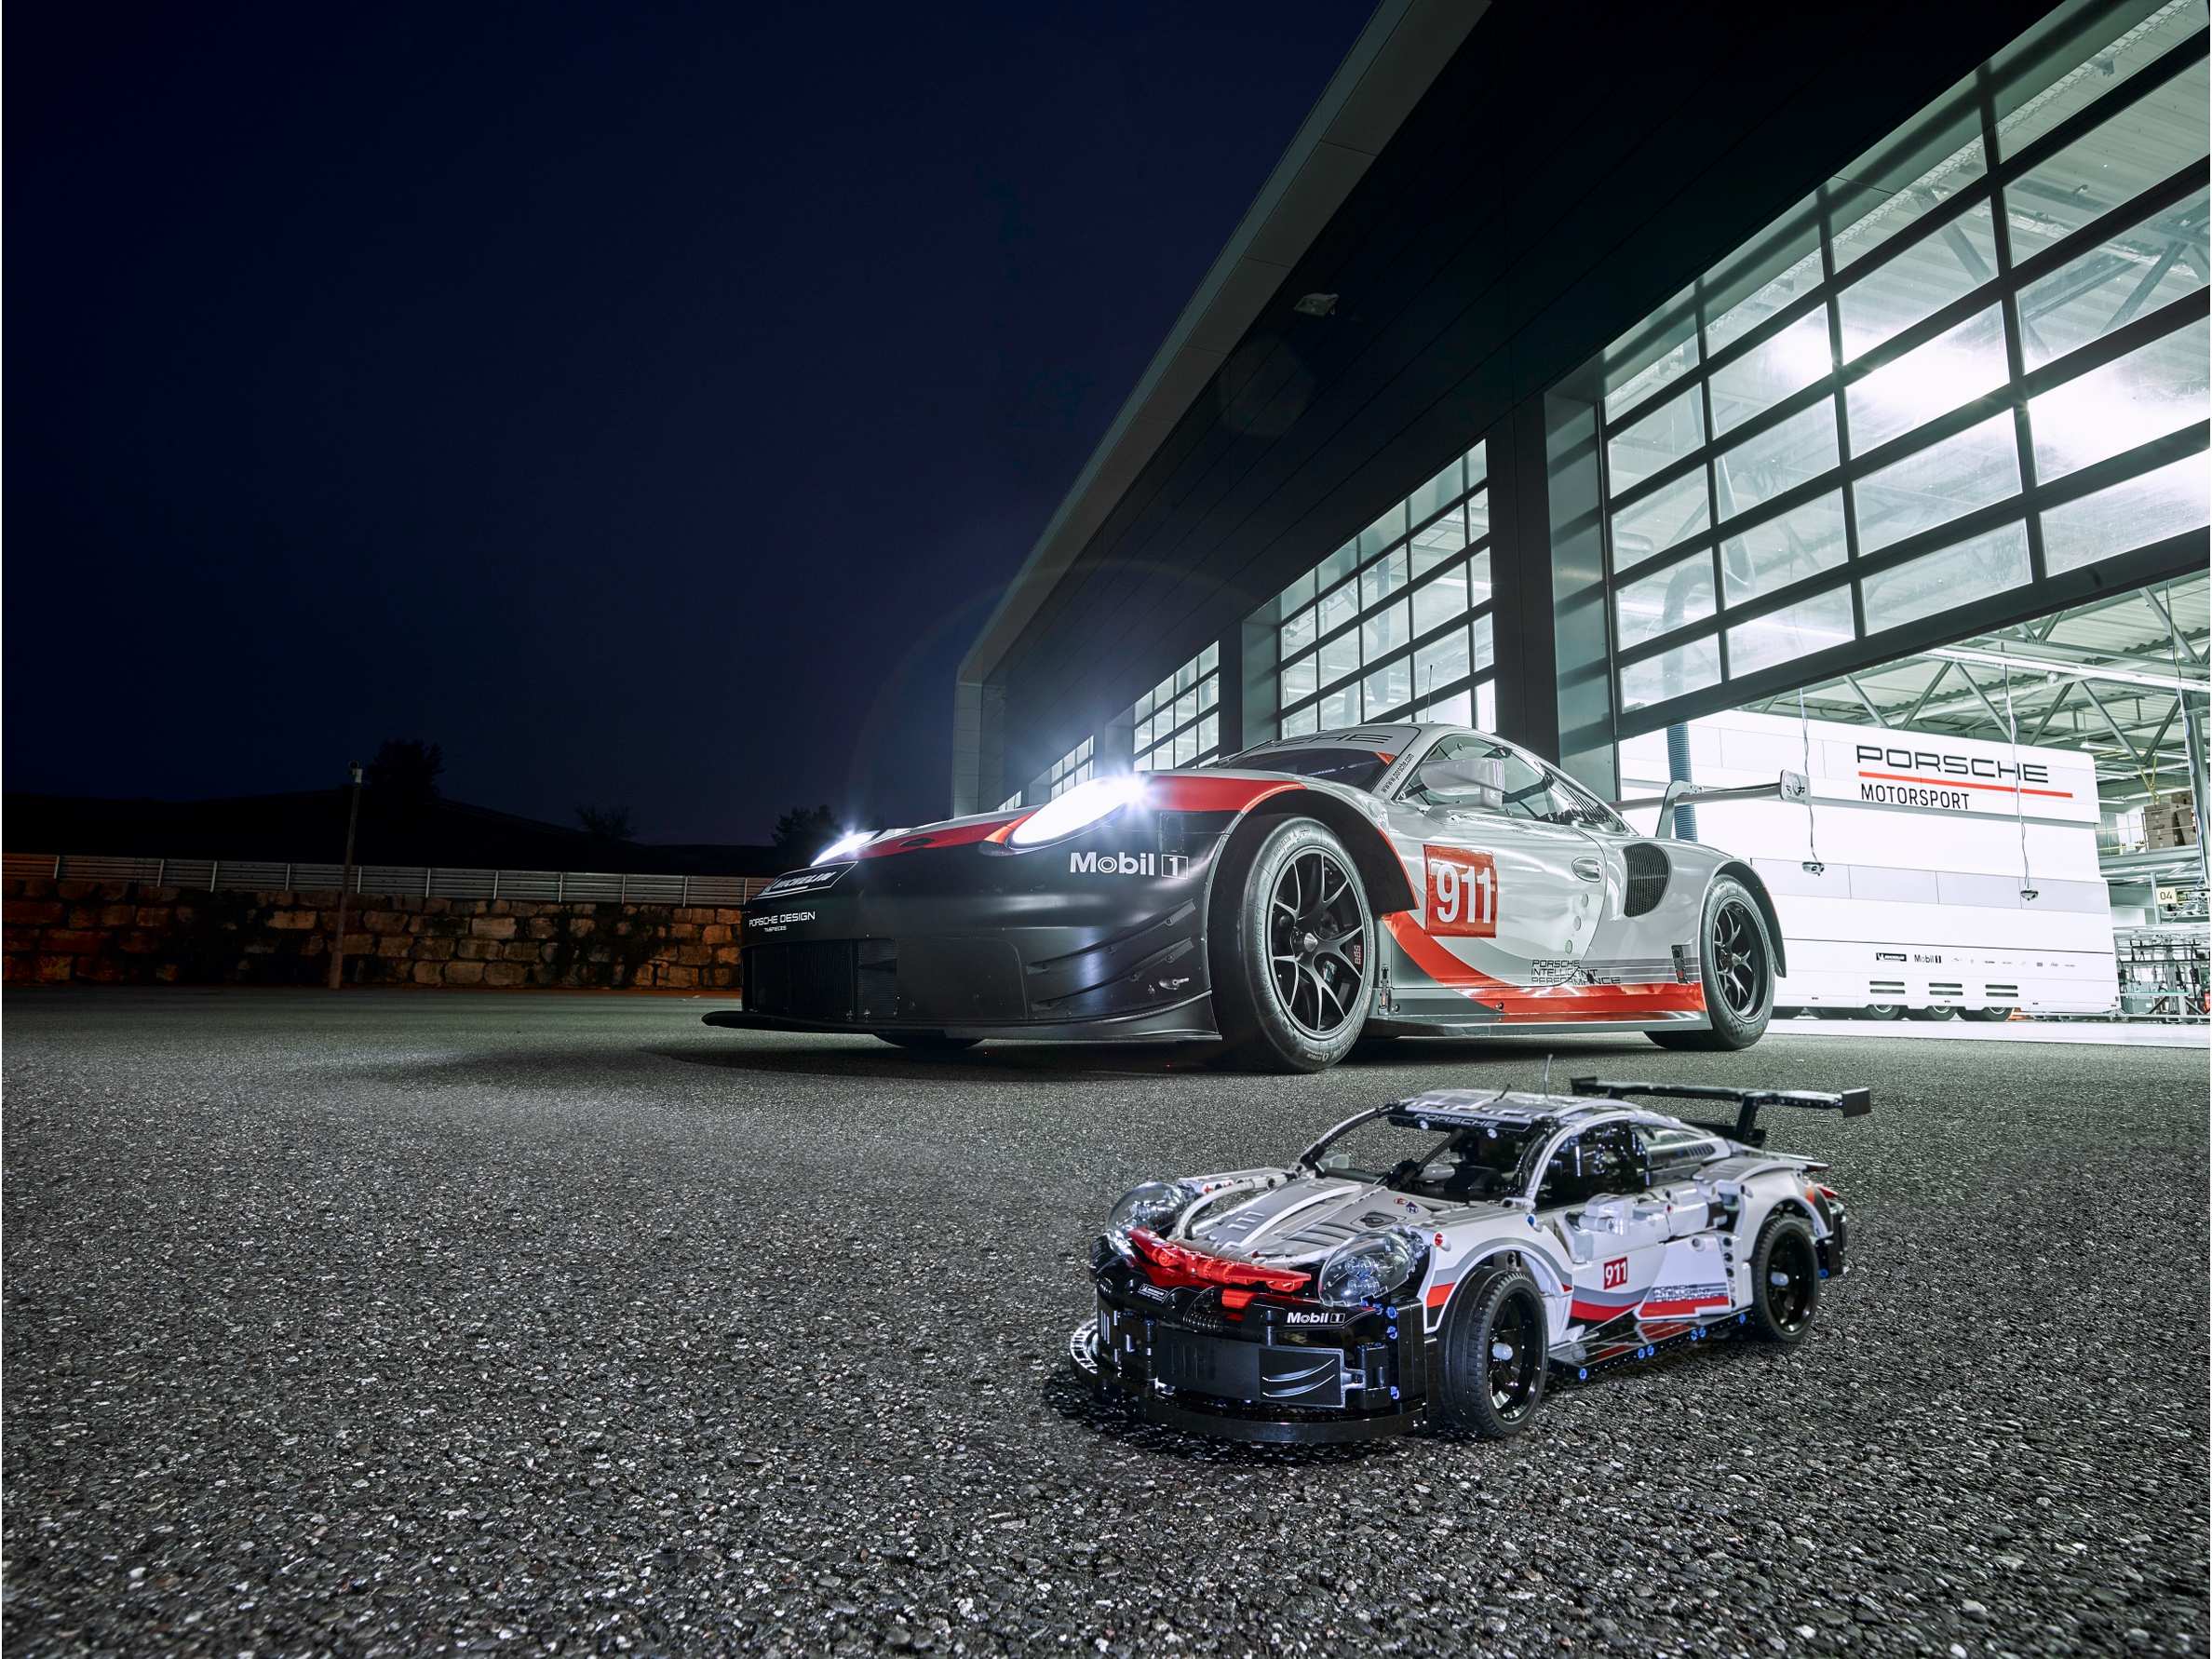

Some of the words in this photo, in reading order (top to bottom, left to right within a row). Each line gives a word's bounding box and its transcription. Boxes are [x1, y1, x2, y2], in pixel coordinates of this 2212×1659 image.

[1856, 745, 2048, 783] PORSCHE
[1861, 783, 1969, 810] MOTORSPORT
[1070, 852, 1154, 876] Mobil
[1436, 863, 1491, 924] 911
[2160, 891, 2173, 900] 04
[749, 915, 778, 928] PORSCHE
[779, 911, 816, 924] DESIGN
[1531, 960, 1580, 968] PORSCHE
[1415, 1113, 1500, 1128] PORSCHE
[1606, 1261, 1626, 1286] 911
[1287, 1312, 1329, 1324] Mobil
